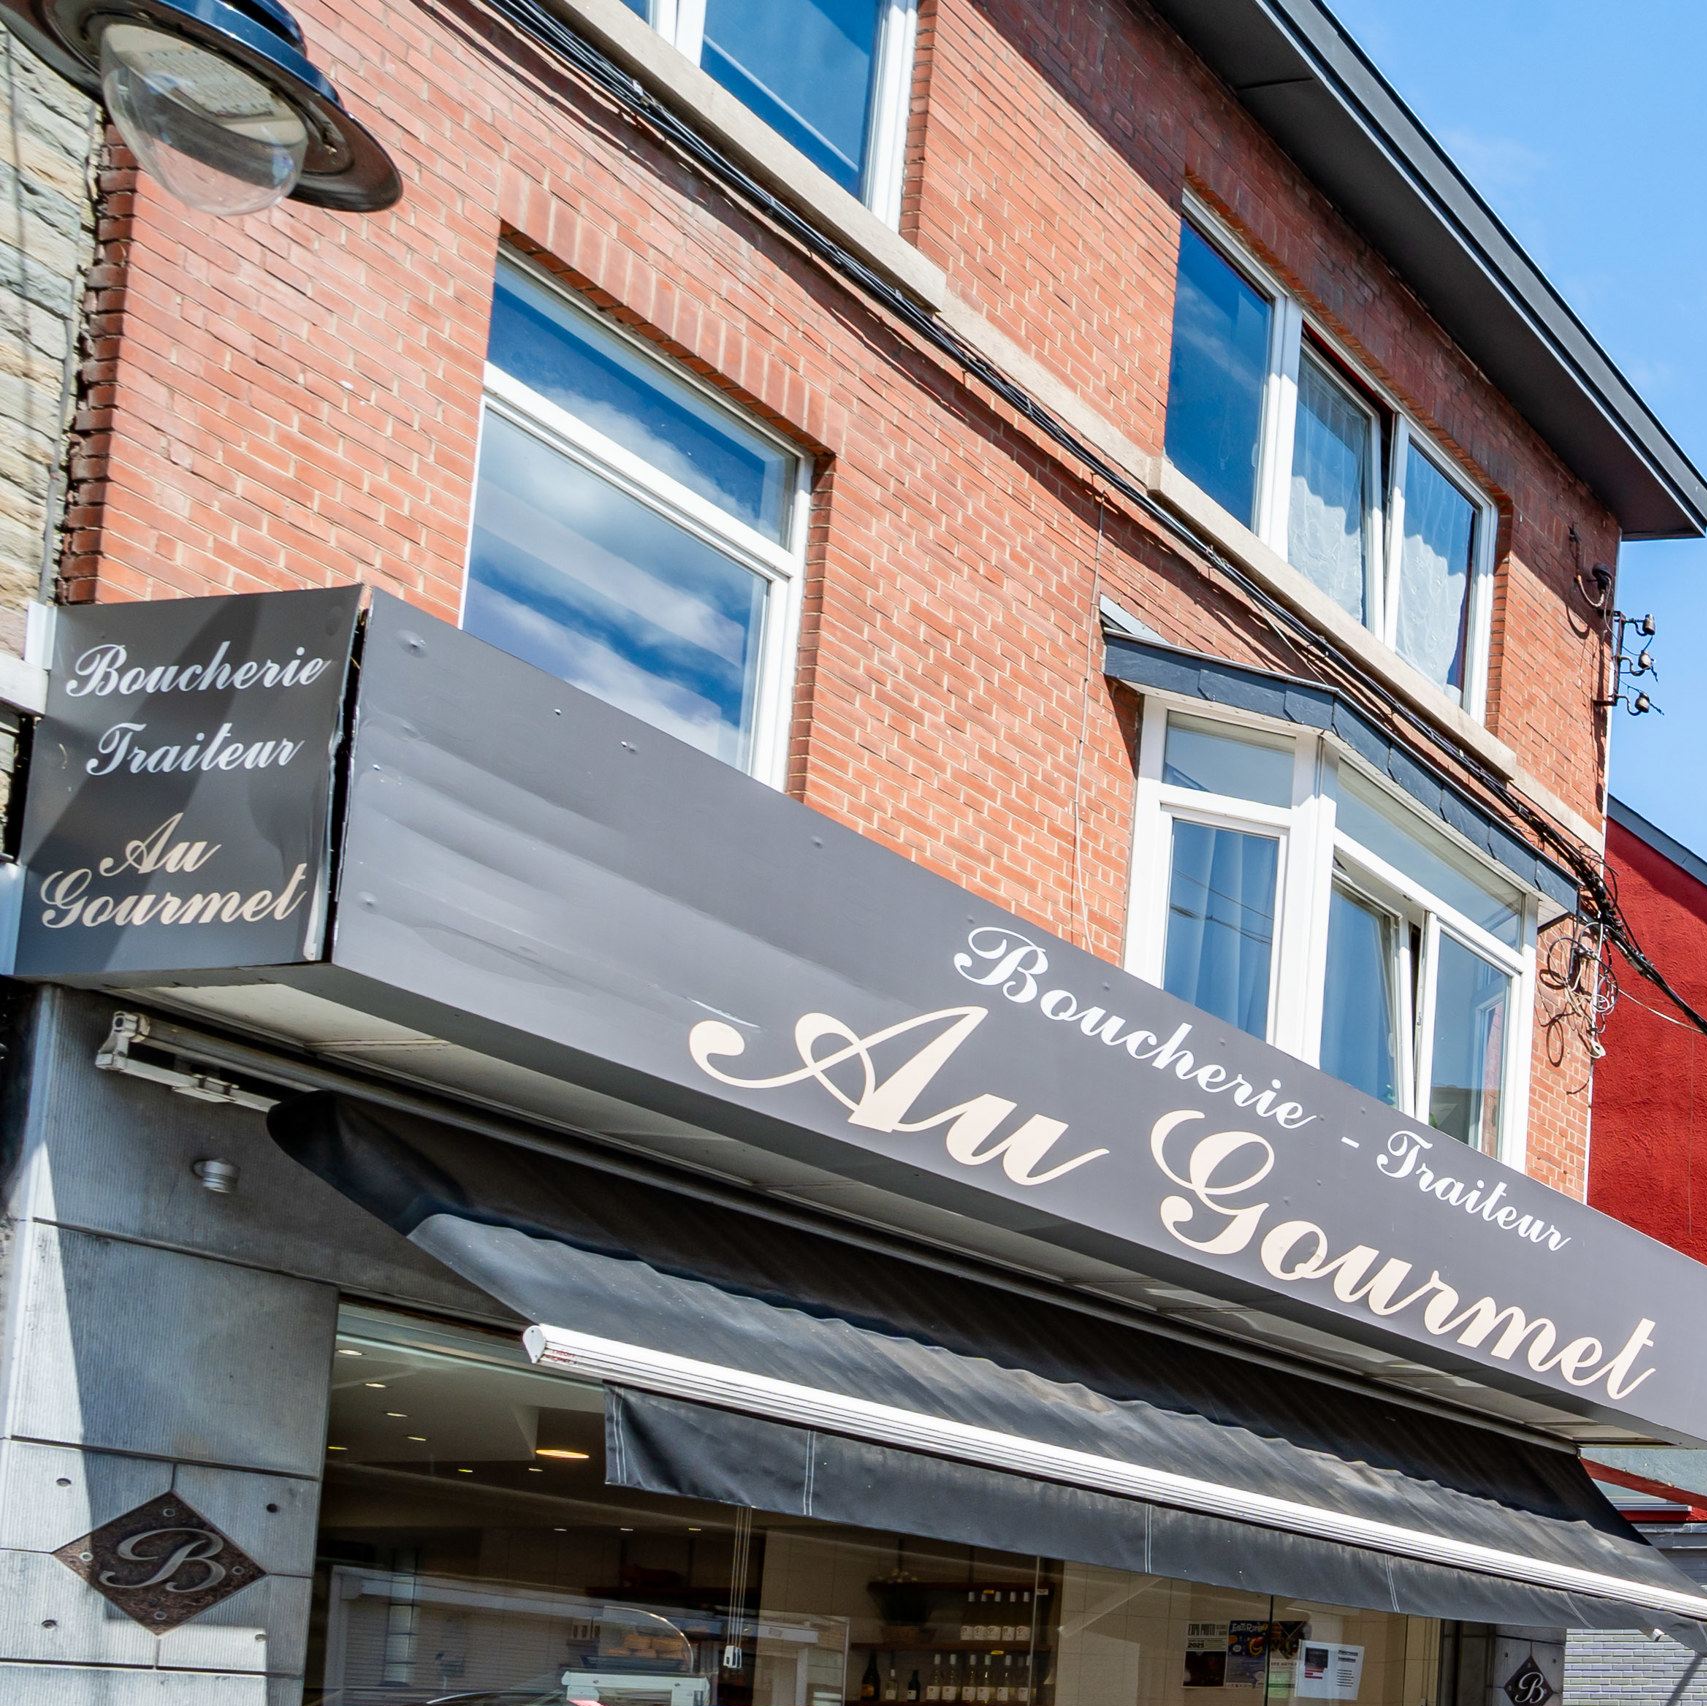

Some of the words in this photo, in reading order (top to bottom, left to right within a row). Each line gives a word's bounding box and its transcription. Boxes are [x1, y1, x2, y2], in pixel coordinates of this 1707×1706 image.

[65, 641, 332, 698] Boucherie
[85, 722, 305, 776] Traiteur
[99, 813, 221, 877] Au
[40, 862, 309, 929] Gourmet
[953, 926, 1317, 1129] Boucherie
[1376, 1130, 1573, 1252] Traiteur
[689, 1006, 1110, 1186] Au
[1150, 1109, 1657, 1400] Gourmet
[101, 1527, 225, 1593] B
[1514, 1671, 1545, 1704] B
